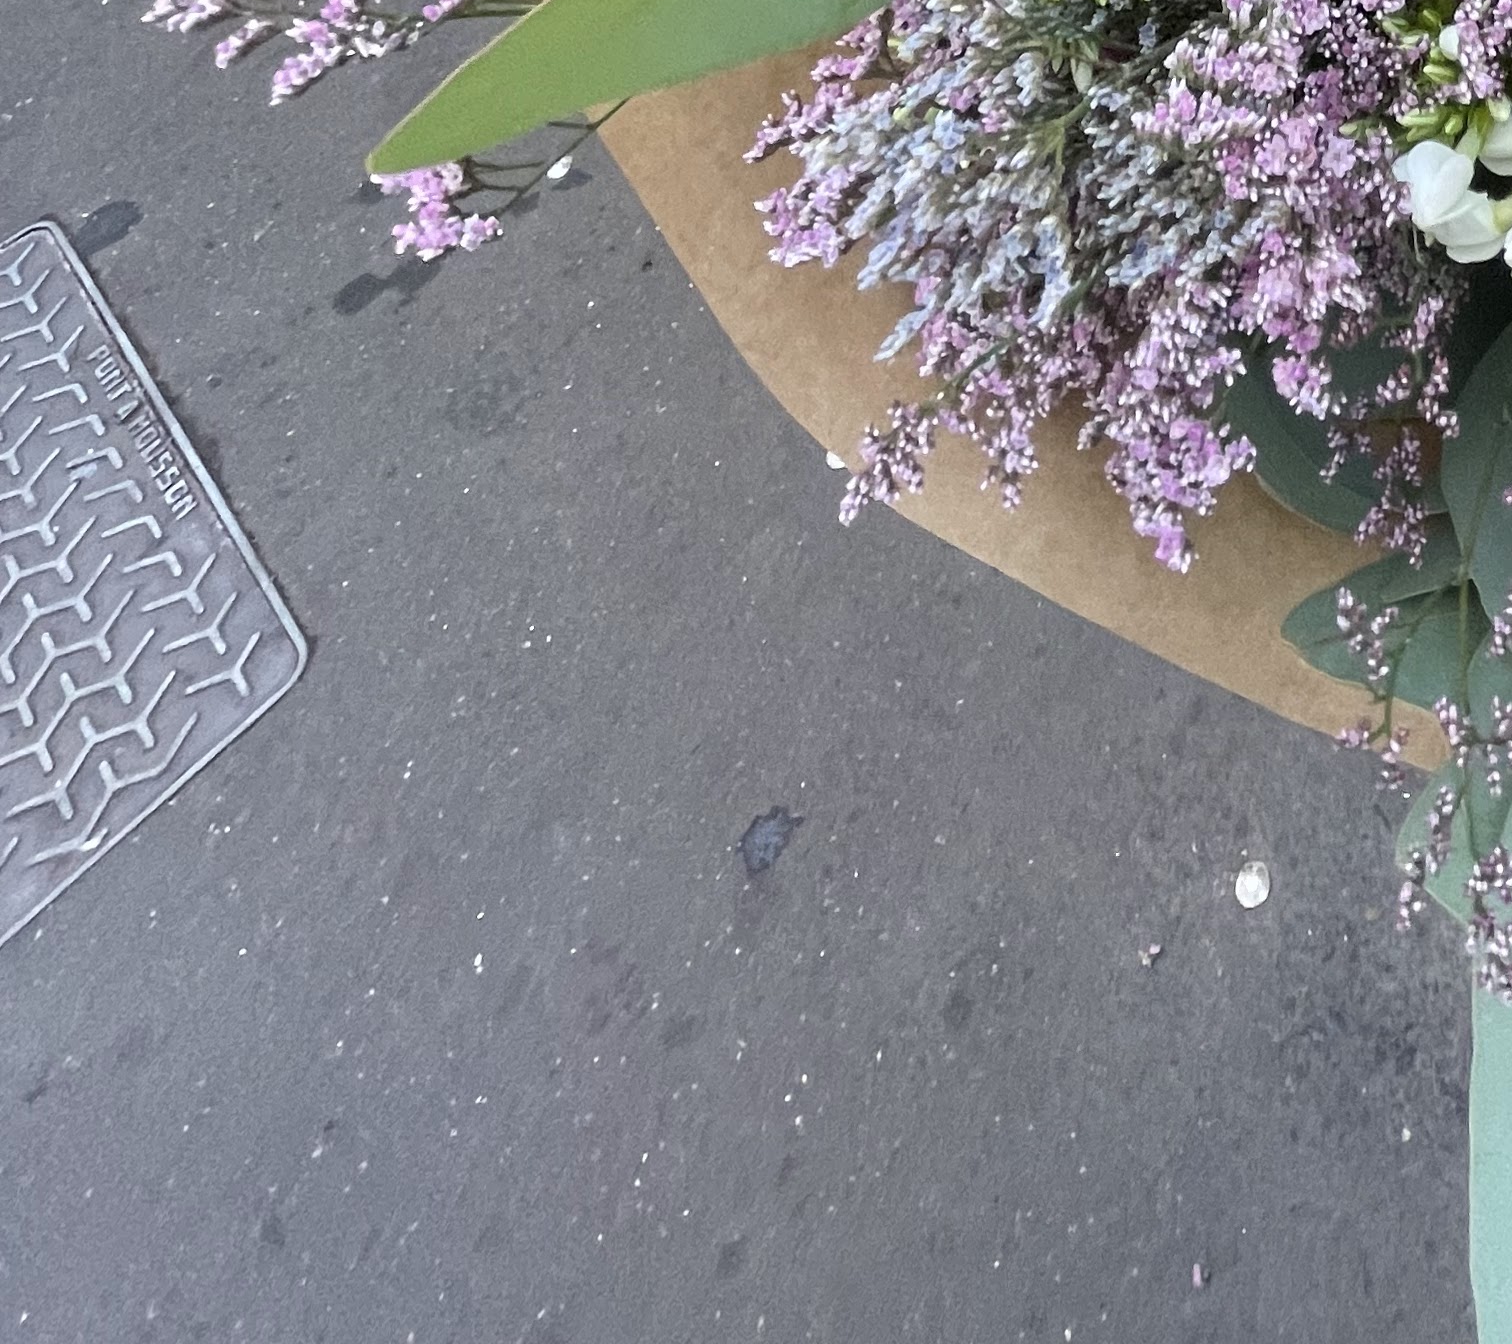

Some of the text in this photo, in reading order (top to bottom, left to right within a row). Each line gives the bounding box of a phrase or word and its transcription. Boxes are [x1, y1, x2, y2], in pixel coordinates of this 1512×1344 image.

[85, 344, 199, 521] PONT A MOUSSON
